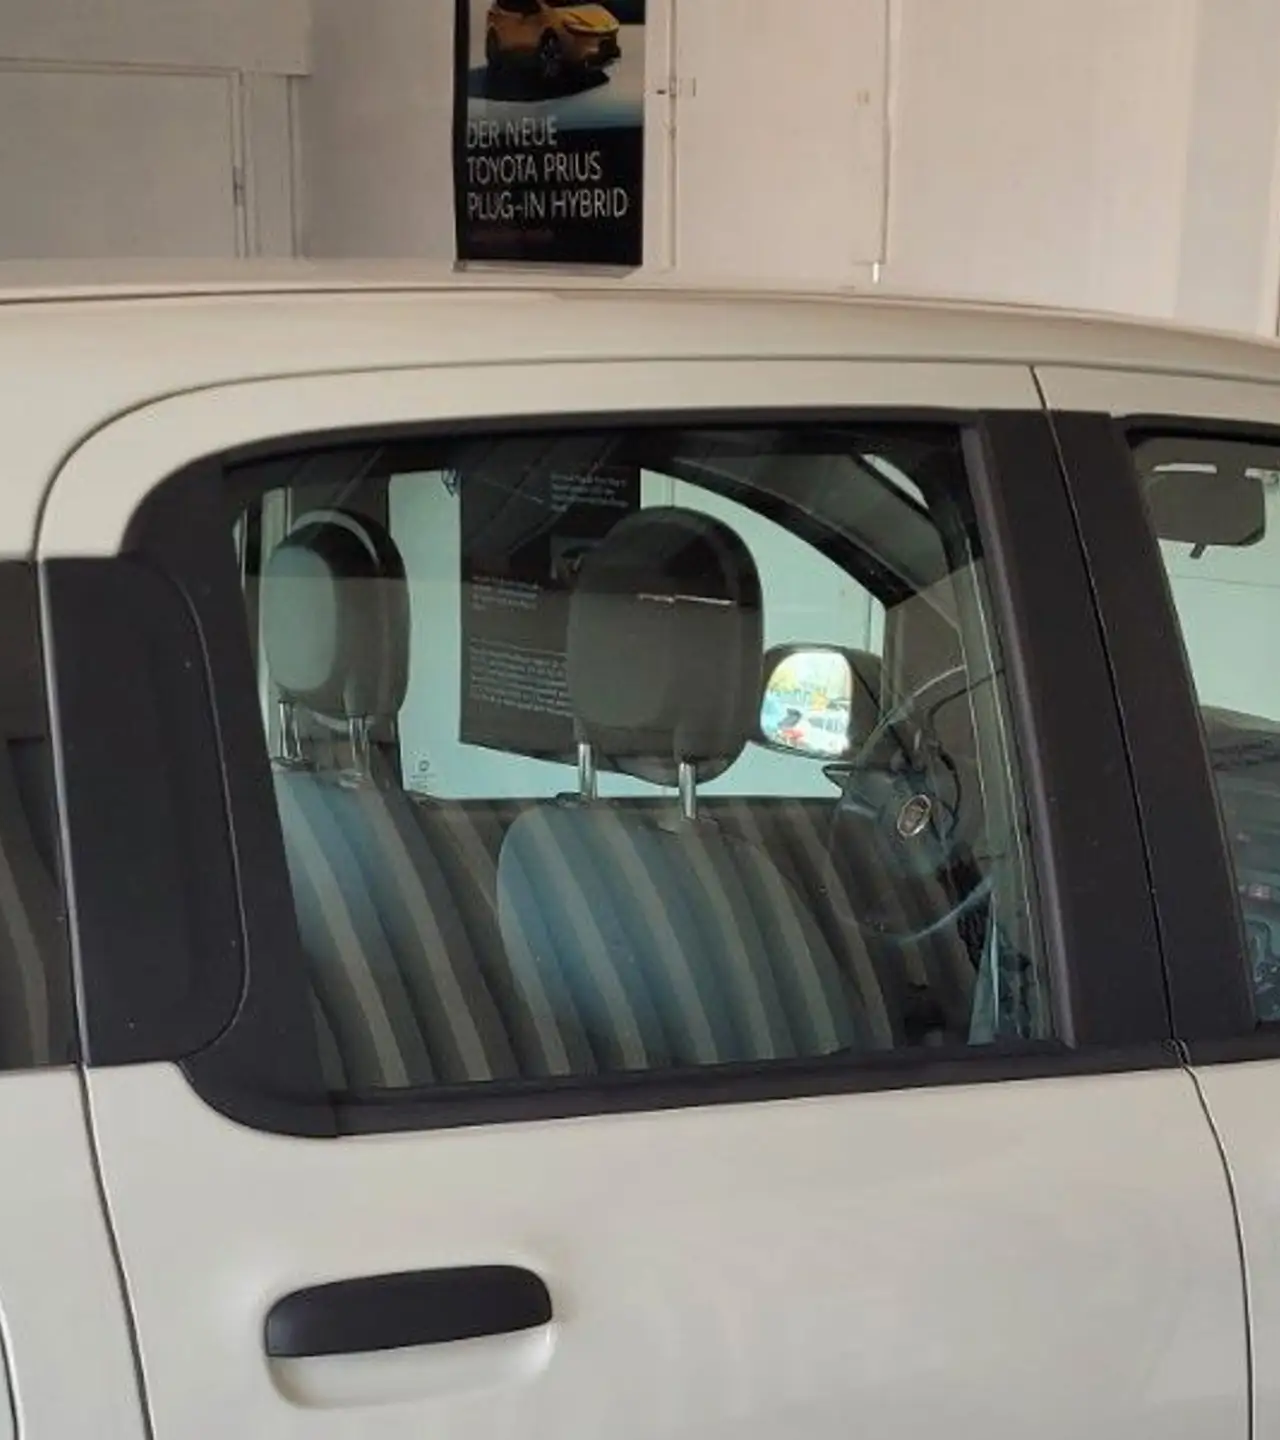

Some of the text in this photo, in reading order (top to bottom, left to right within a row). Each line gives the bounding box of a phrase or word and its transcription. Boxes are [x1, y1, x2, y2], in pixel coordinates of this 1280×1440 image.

[467, 115, 558, 149] DER NEUE
[467, 151, 603, 185] TOYOTA PRIUS
[467, 187, 629, 221] PLUG-IN HYBRID
